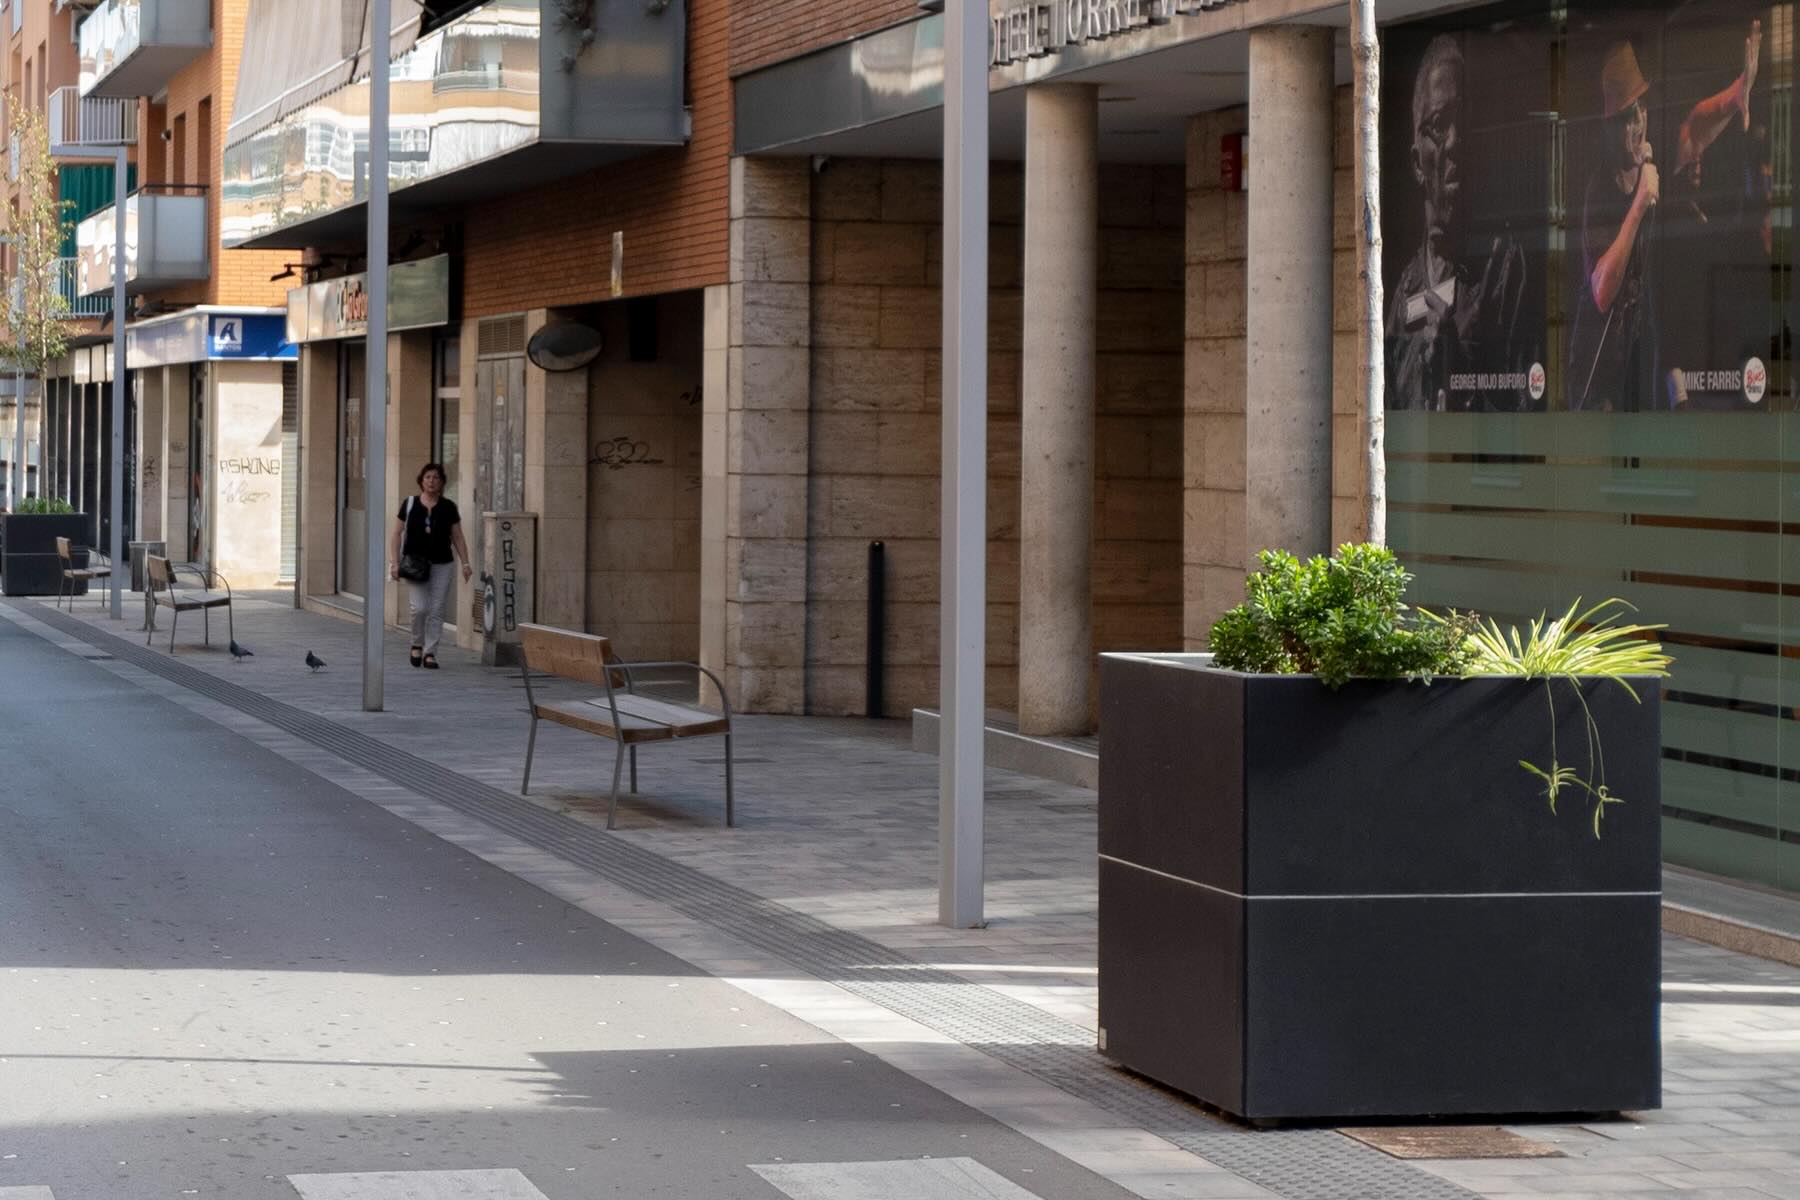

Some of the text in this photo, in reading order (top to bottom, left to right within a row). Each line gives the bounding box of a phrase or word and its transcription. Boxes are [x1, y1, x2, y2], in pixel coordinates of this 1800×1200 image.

[1450, 374, 1476, 390] GEORGE
[1477, 374, 1498, 390] MOJO
[1498, 374, 1527, 390] BUFORD
[1682, 370, 1705, 391] MIKE
[1707, 369, 1741, 391] FARRIS
